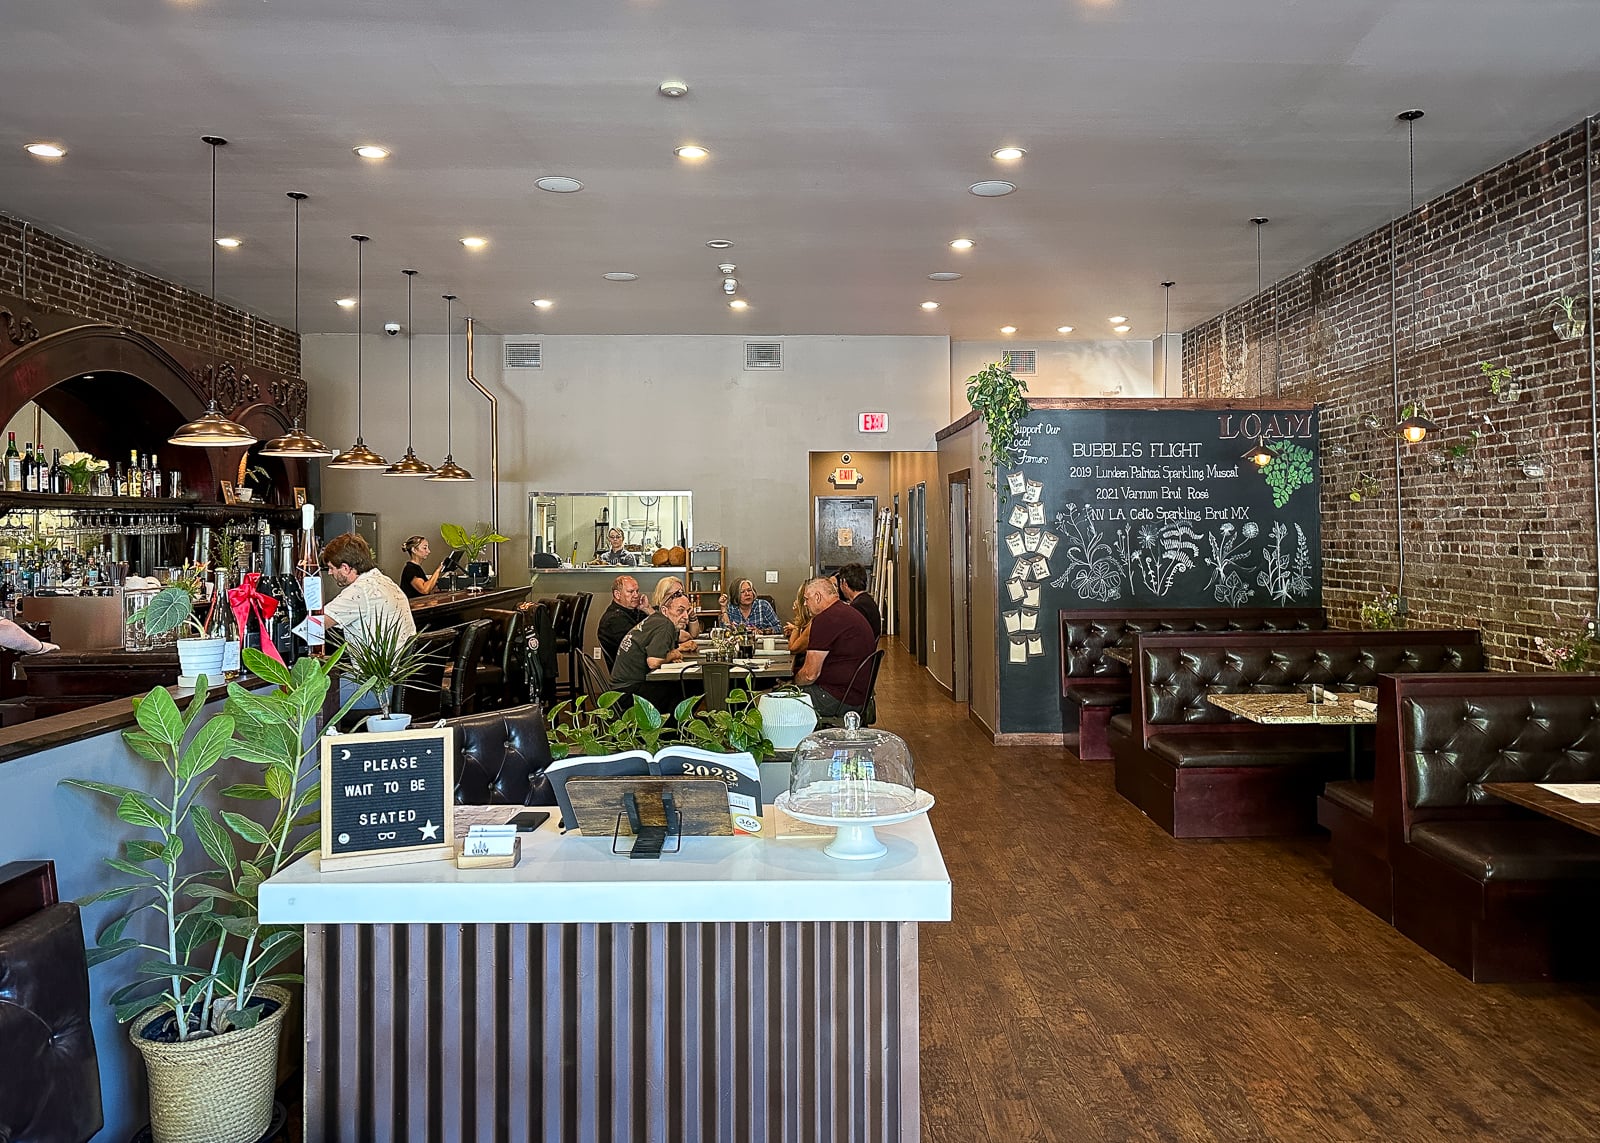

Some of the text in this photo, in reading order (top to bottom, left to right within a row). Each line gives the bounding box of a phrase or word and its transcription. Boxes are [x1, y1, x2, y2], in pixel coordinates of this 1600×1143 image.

[863, 414, 885, 431] EXIT
[1013, 419, 1061, 437] Support Our
[1217, 412, 1313, 439] LOAM
[1004, 436, 1032, 452] Local
[1072, 442, 1203, 458] BUBBLES FLIGHT
[1014, 448, 1049, 465] Farmers
[839, 469, 854, 481] EXIT
[1070, 466, 1092, 478] 2019
[1162, 465, 1205, 483] Sparkling
[1206, 464, 1239, 478] Muscat
[1096, 486, 1210, 500] 2021 Varnum Brut Rosé
[1091, 506, 1250, 525] NV LA Cetto Sparkling Brut MX
[363, 756, 418, 772] PLEASE
[682, 762, 739, 781] 2023
[344, 778, 426, 797] WAIT TO BE
[358, 809, 417, 826] SEATED
